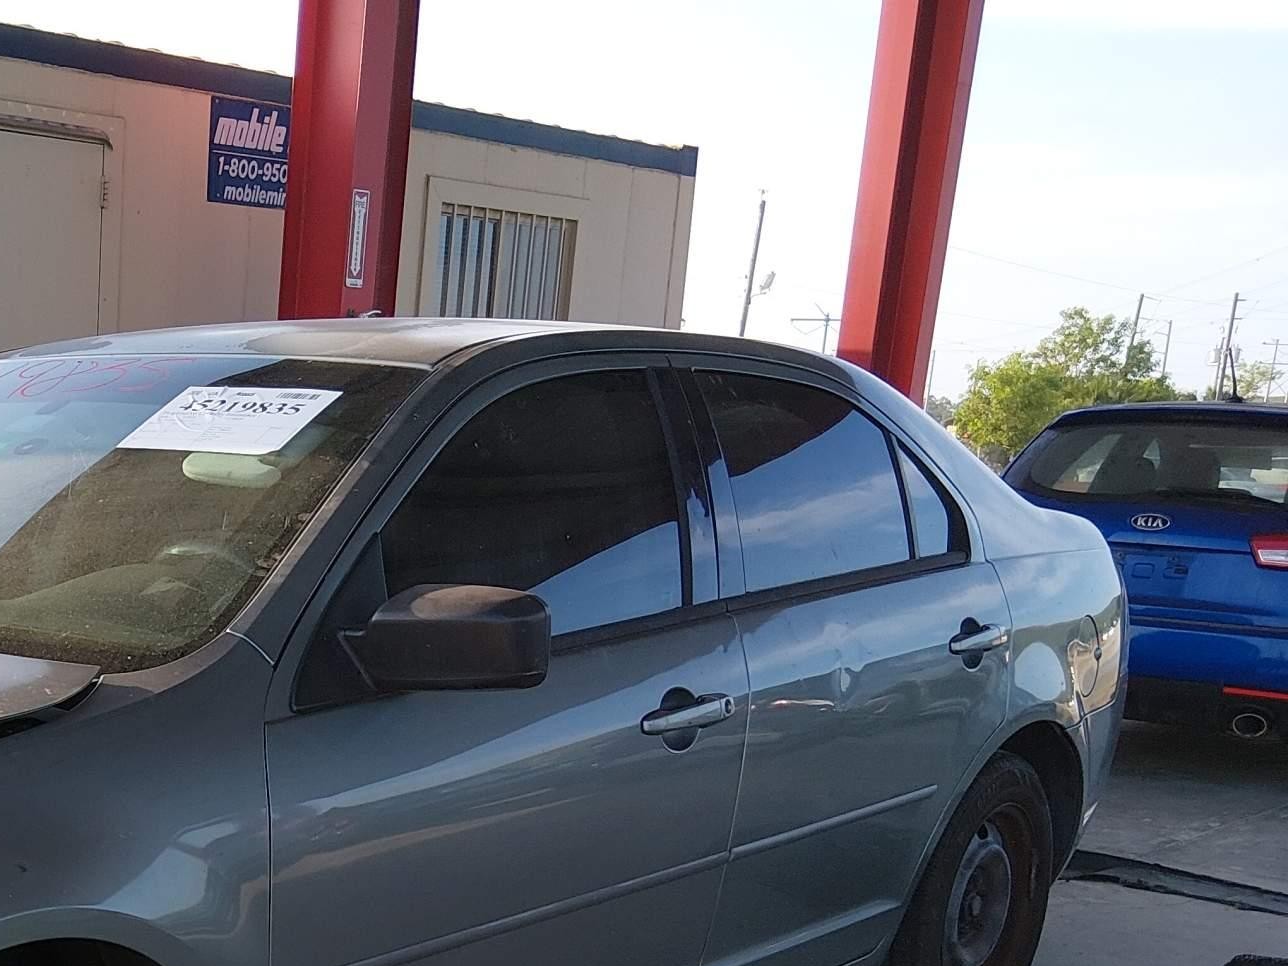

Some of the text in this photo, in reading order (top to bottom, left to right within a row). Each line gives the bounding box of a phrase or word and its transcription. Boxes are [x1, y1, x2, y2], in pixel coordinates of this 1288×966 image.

[214, 107, 287, 153] mobile
[179, 399, 307, 416] 45219835
[1137, 516, 1163, 528] KIA
